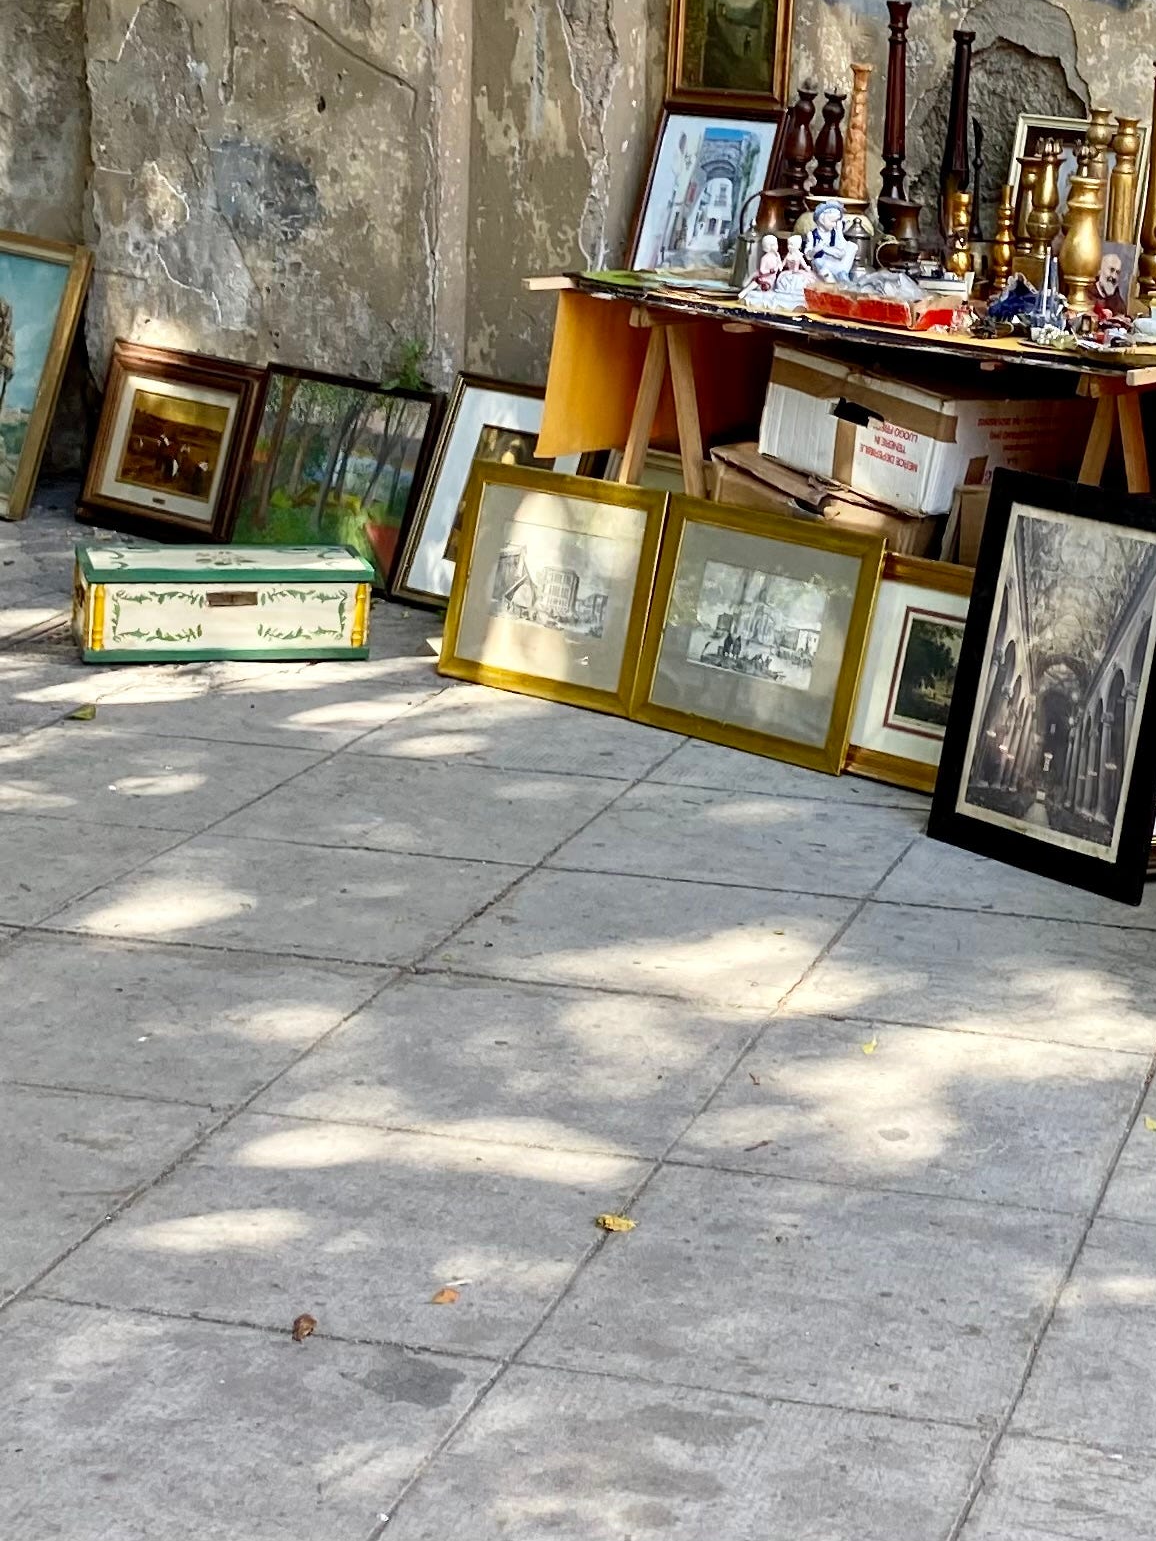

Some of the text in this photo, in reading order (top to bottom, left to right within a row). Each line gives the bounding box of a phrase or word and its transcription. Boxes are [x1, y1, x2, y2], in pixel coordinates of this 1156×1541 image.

[894, 427, 918, 443] LUOGO
[881, 436, 906, 454] TENERE
[895, 456, 919, 472] MERCE
